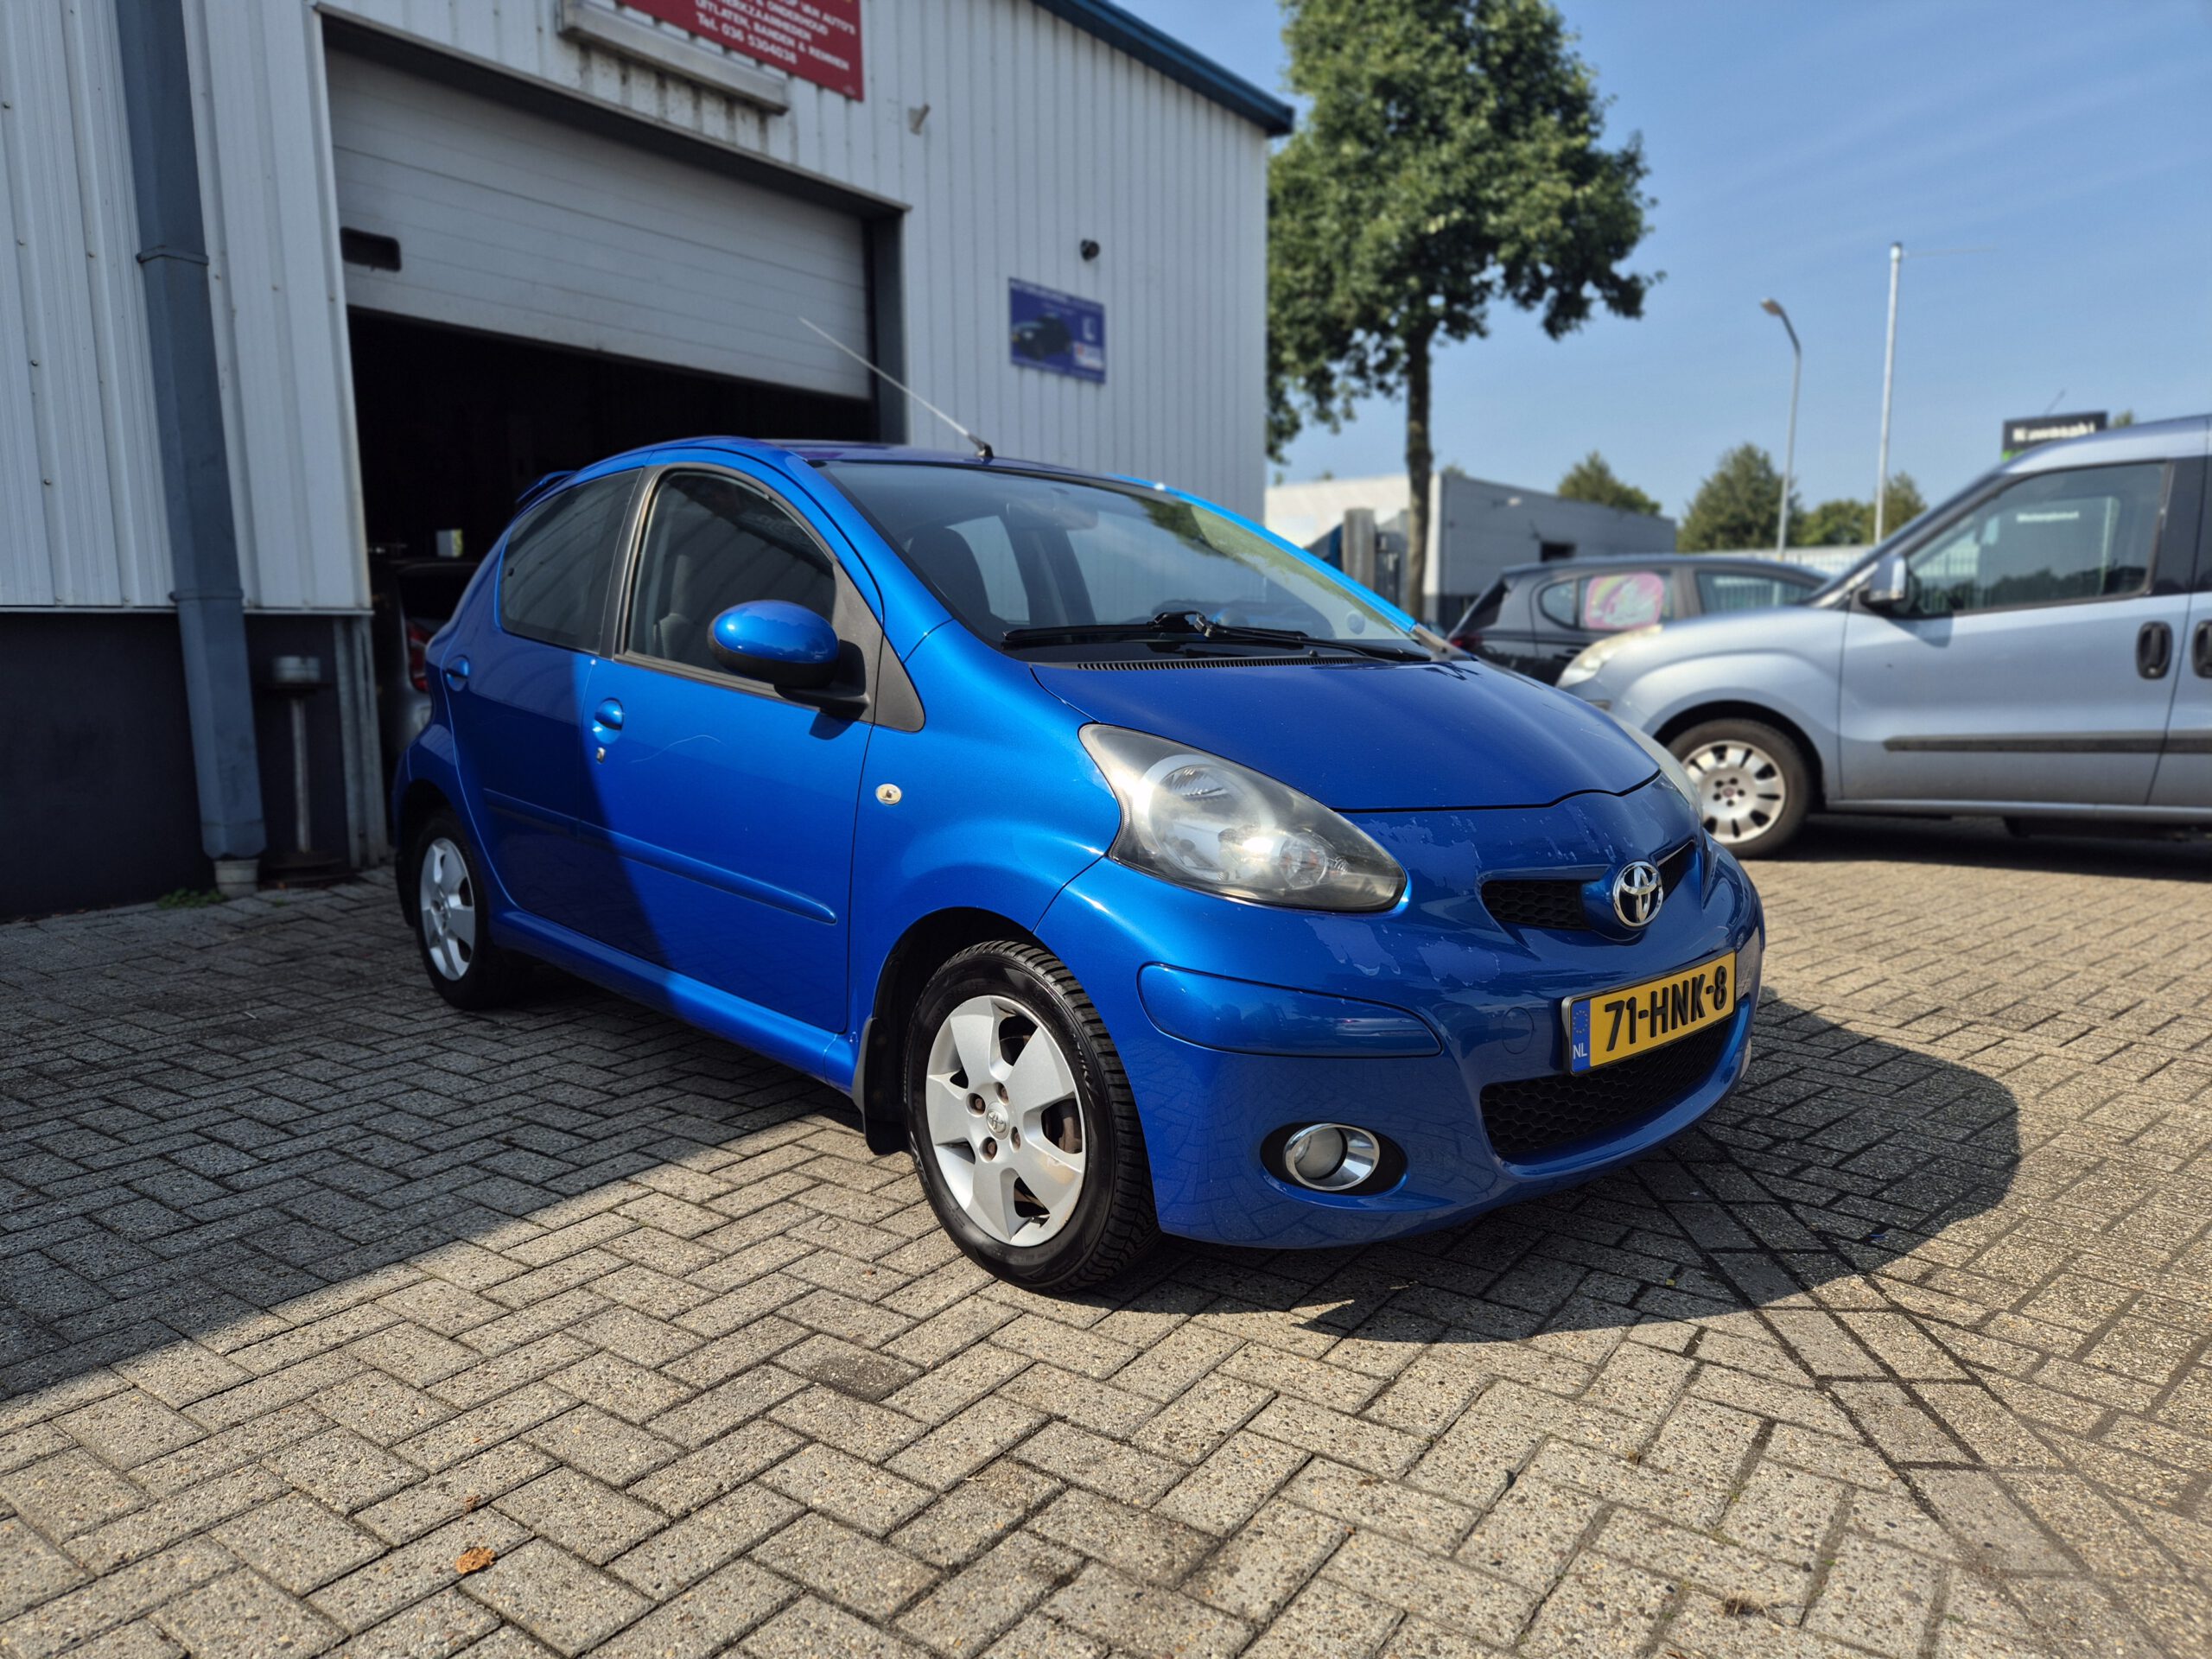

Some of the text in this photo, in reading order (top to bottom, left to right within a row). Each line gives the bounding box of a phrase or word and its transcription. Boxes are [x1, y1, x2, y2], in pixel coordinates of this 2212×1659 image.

[696, 11, 719, 31] Tel.
[721, 23, 744, 42] 036
[766, 0, 828, 35] ONDERHOUD
[753, 22, 795, 47] BANDEN
[1605, 965, 1727, 1052] 71-HNK-8
[1573, 1043, 1587, 1059] NL
